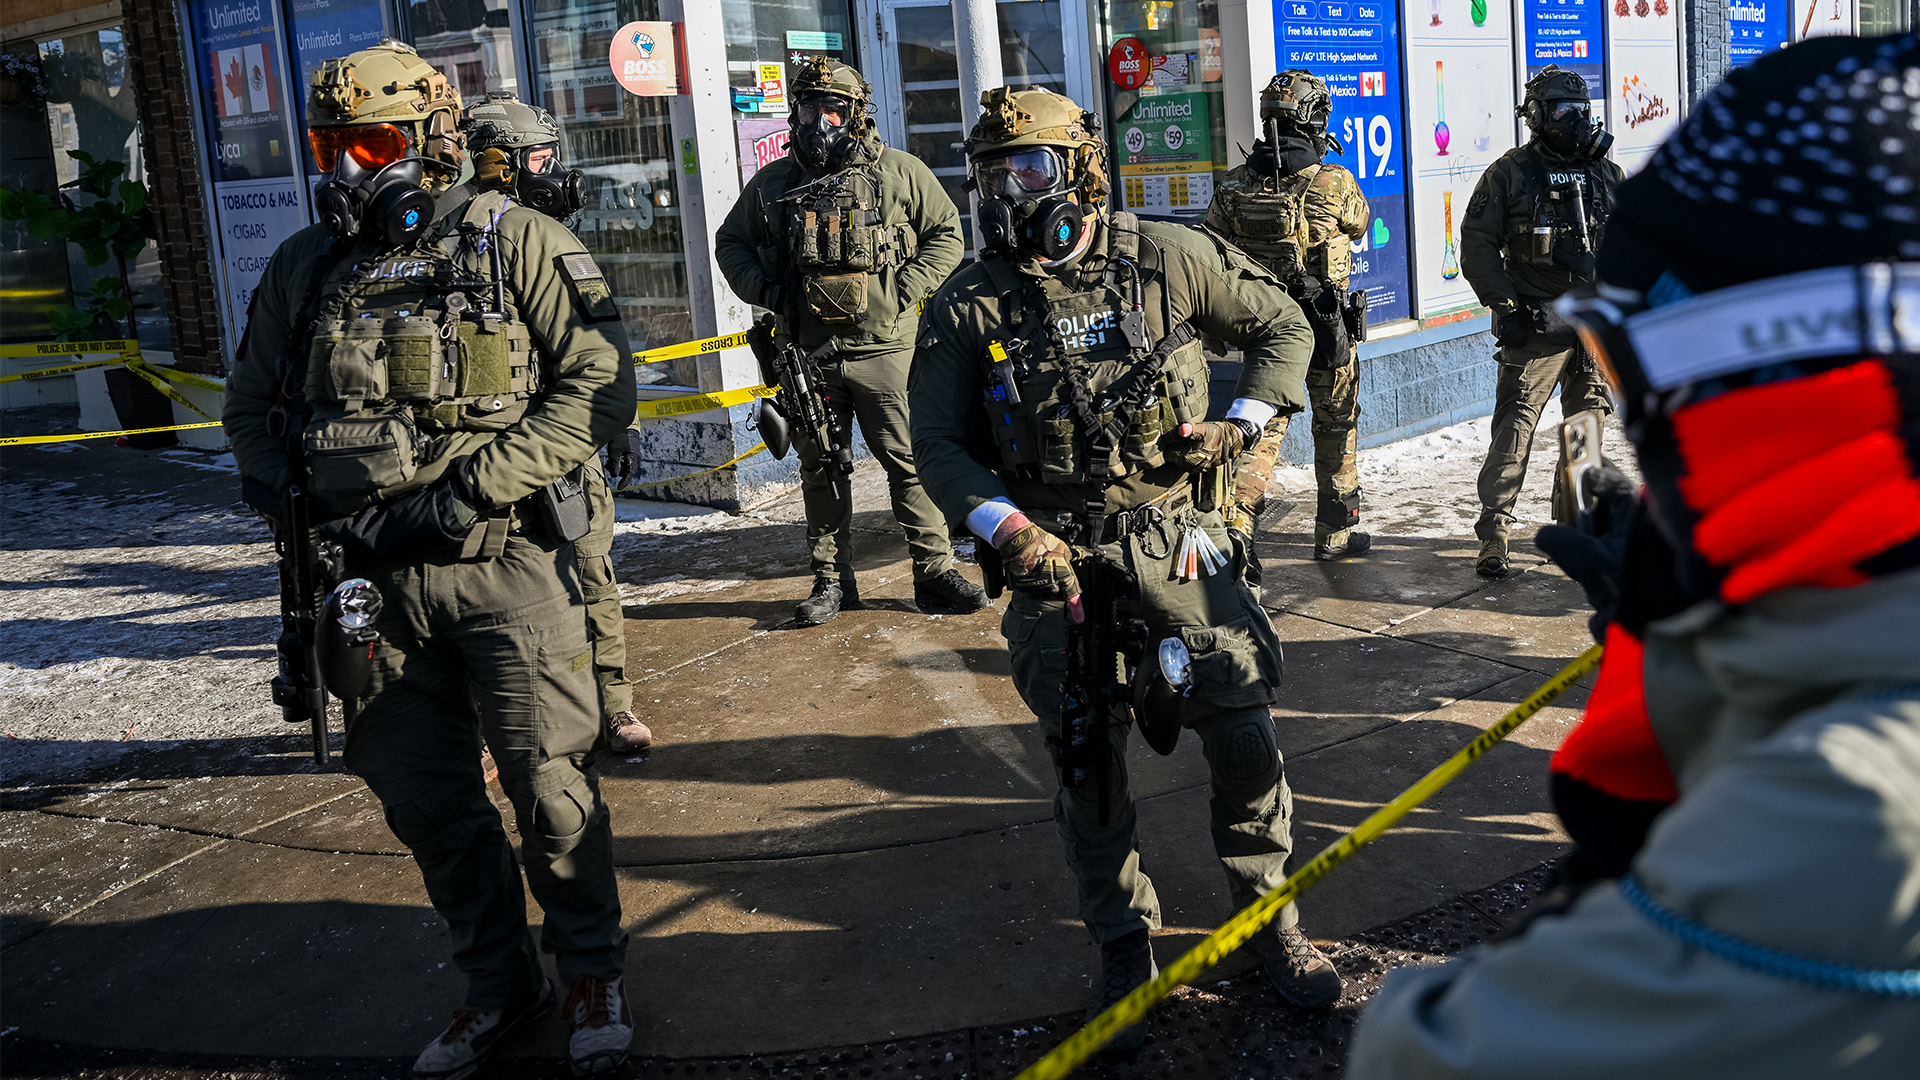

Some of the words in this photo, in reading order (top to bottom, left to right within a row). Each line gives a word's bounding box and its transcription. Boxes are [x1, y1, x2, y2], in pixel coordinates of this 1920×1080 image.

[208, 0, 261, 29] Unlimited
[1292, 4, 1307, 16] Talk
[1327, 5, 1342, 17] Text
[1359, 7, 1375, 18] Data
[1728, 0, 1765, 23] nlimited
[1288, 26, 1301, 36] Free
[1301, 26, 1313, 36] Talk
[1313, 26, 1319, 36] &
[1319, 27, 1331, 36] Text
[1331, 27, 1338, 36] to
[1338, 28, 1348, 37] 100
[296, 27, 342, 51] Unlimited
[1290, 52, 1300, 61] 5G
[1316, 52, 1326, 61] LTE
[1326, 53, 1340, 63] High
[1340, 53, 1357, 63] Speed
[1535, 49, 1553, 58] Canada
[1553, 49, 1557, 58] &
[1557, 49, 1573, 58] Mexico
[624, 60, 667, 75] BOSS
[1119, 60, 1140, 69] BOSS
[764, 81, 778, 90] We
[1273, 76, 1289, 86] X2
[1329, 85, 1357, 96] Mexico
[1132, 99, 1192, 119] Unlimited
[1126, 132, 1143, 147] $49
[1166, 130, 1182, 145] $59
[215, 142, 240, 163] Lyca
[1549, 172, 1586, 185] POLICE
[222, 192, 267, 210] TOBACCO
[269, 192, 276, 208] &
[278, 190, 298, 207] MAS
[233, 223, 267, 239] CIGARS
[1046, 310, 1117, 338] OLICE
[701, 337, 733, 352] CROSS
[736, 333, 750, 345] OT
[1062, 331, 1106, 350] HSI
[37, 344, 59, 354] POLICE
[61, 343, 77, 353] LINE
[78, 342, 88, 351] DO
[89, 342, 103, 351] NOT
[104, 341, 126, 350] CROSS
